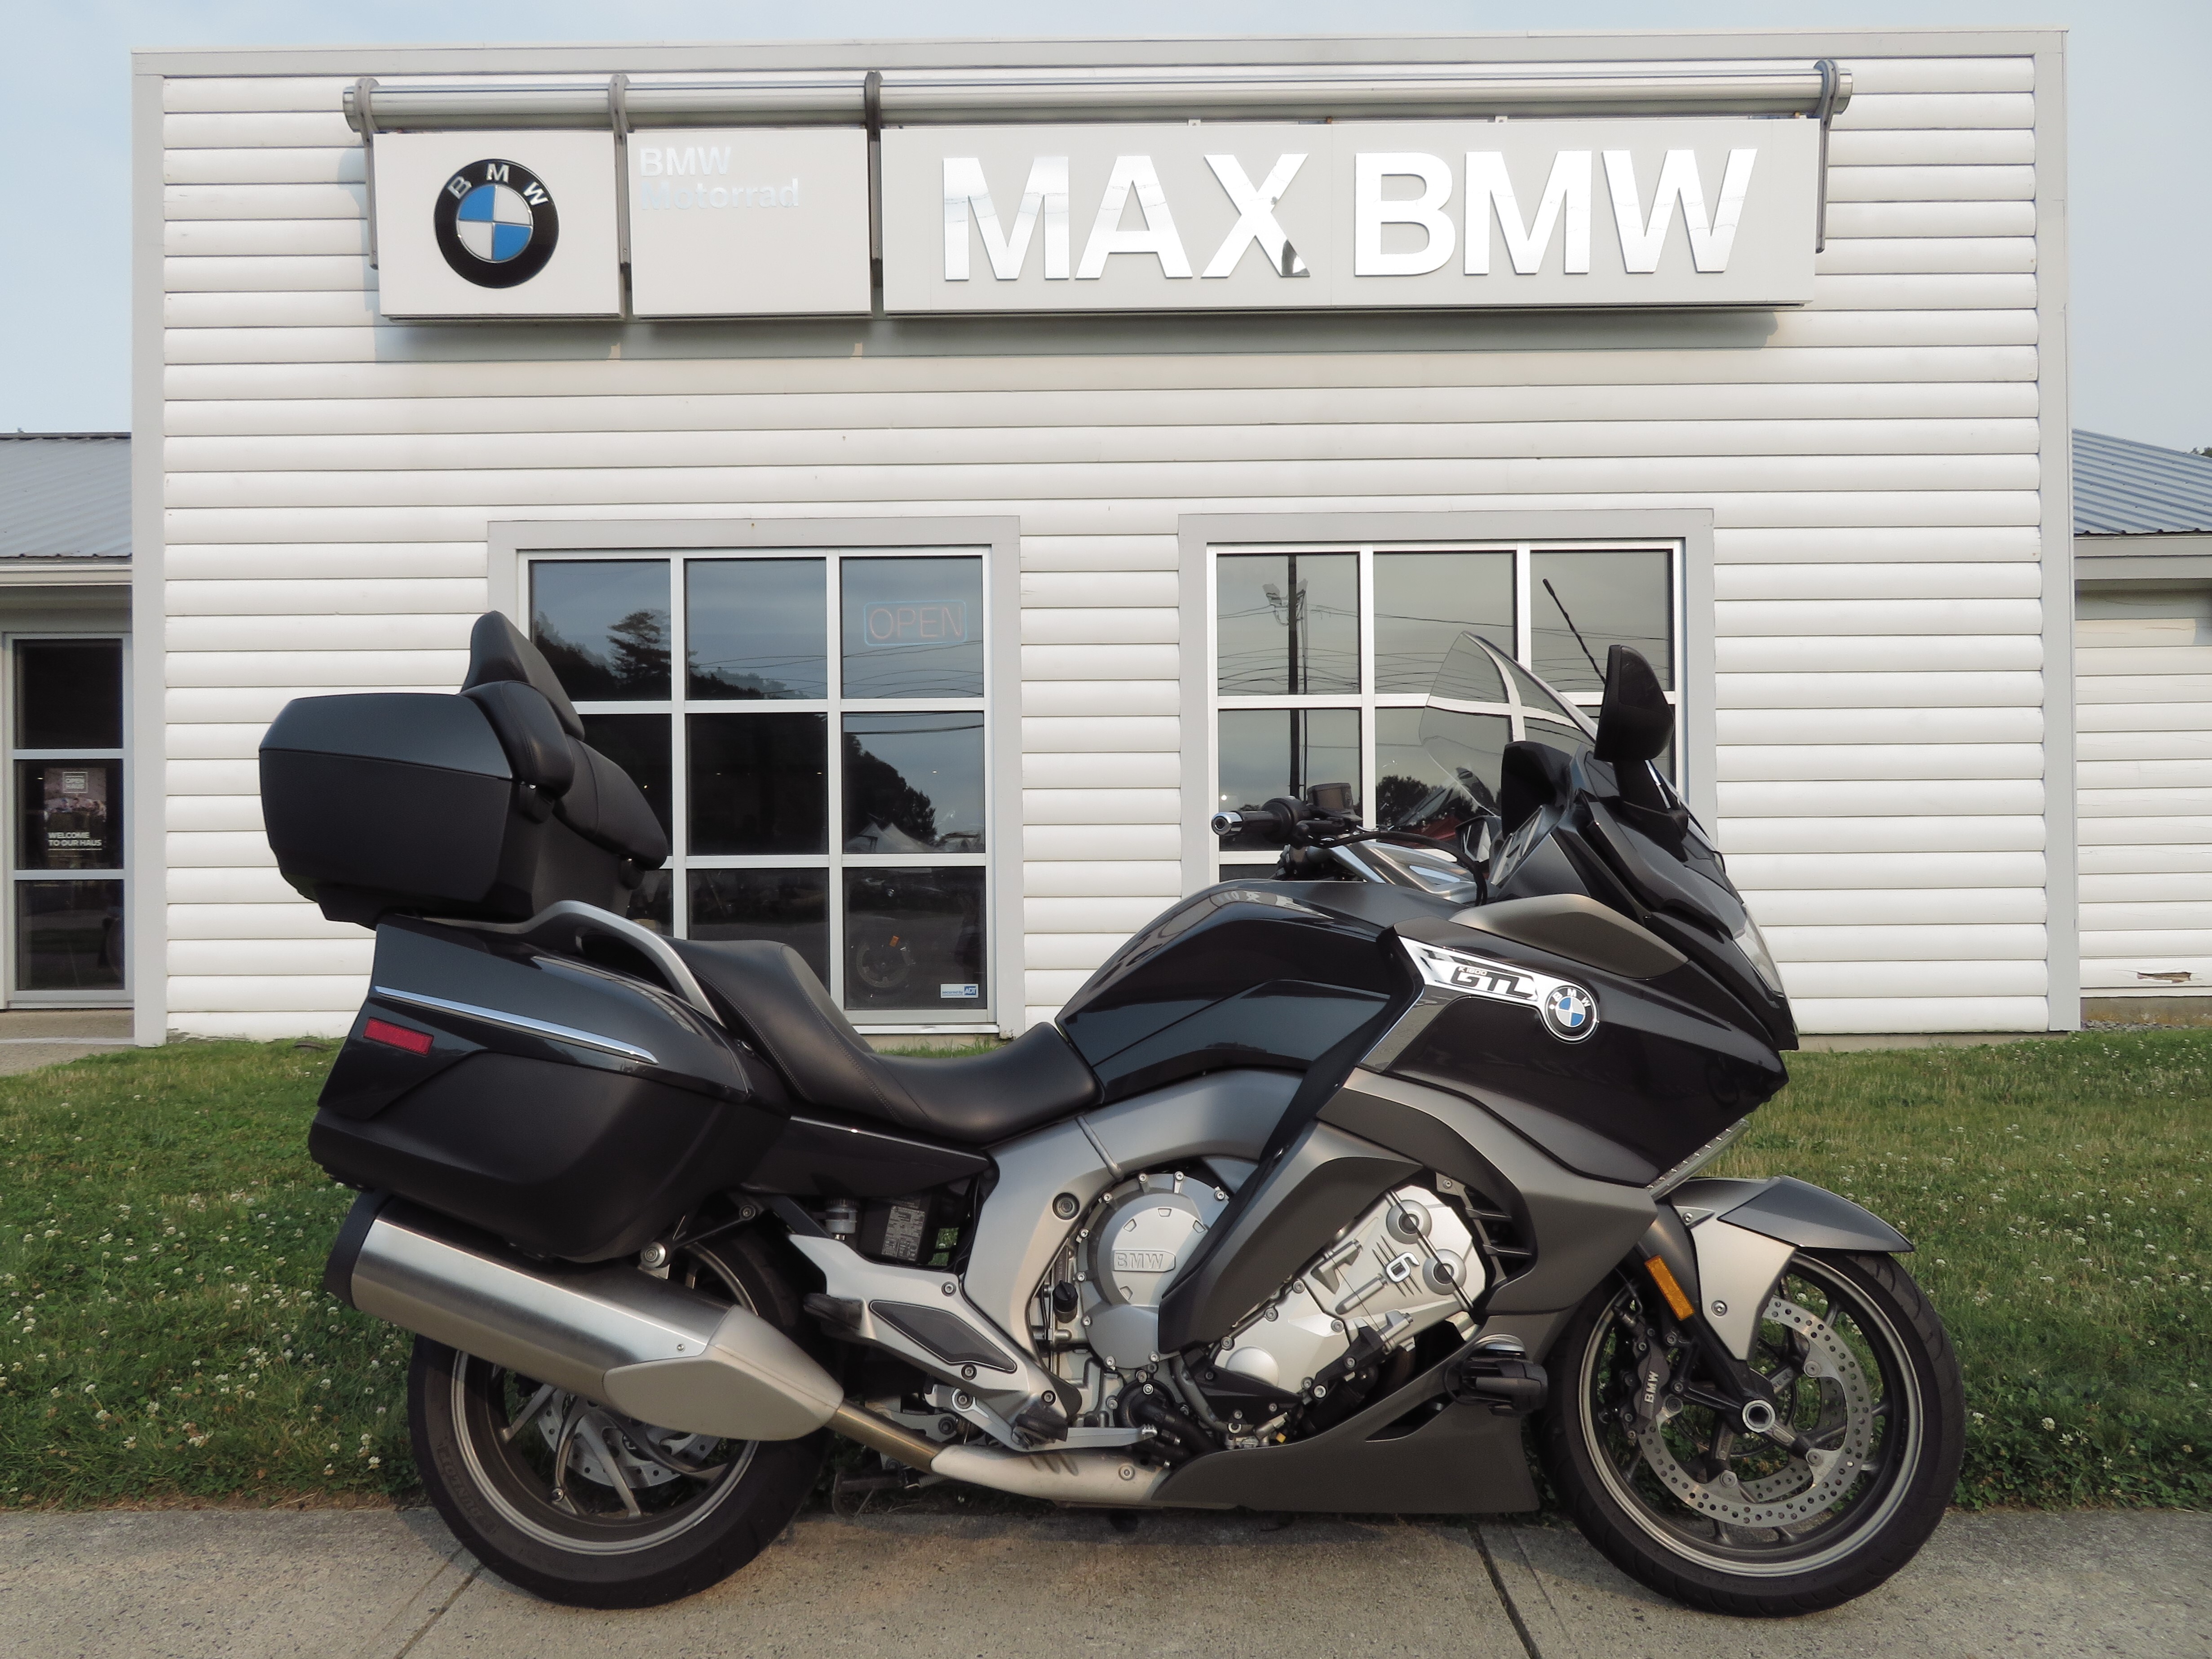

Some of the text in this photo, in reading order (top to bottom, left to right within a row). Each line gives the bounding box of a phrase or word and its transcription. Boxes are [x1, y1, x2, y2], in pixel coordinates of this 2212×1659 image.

[640, 146, 731, 177] BMW
[447, 163, 549, 206] BMW
[641, 178, 799, 210] Motorrad
[943, 148, 1758, 281] MAX BMW
[870, 606, 962, 640] OPEN
[1451, 966, 1533, 998] GTL
[1552, 988, 1591, 1007] BMW
[1115, 1253, 1164, 1269] BMW
[1644, 1371, 1659, 1403] BMW
